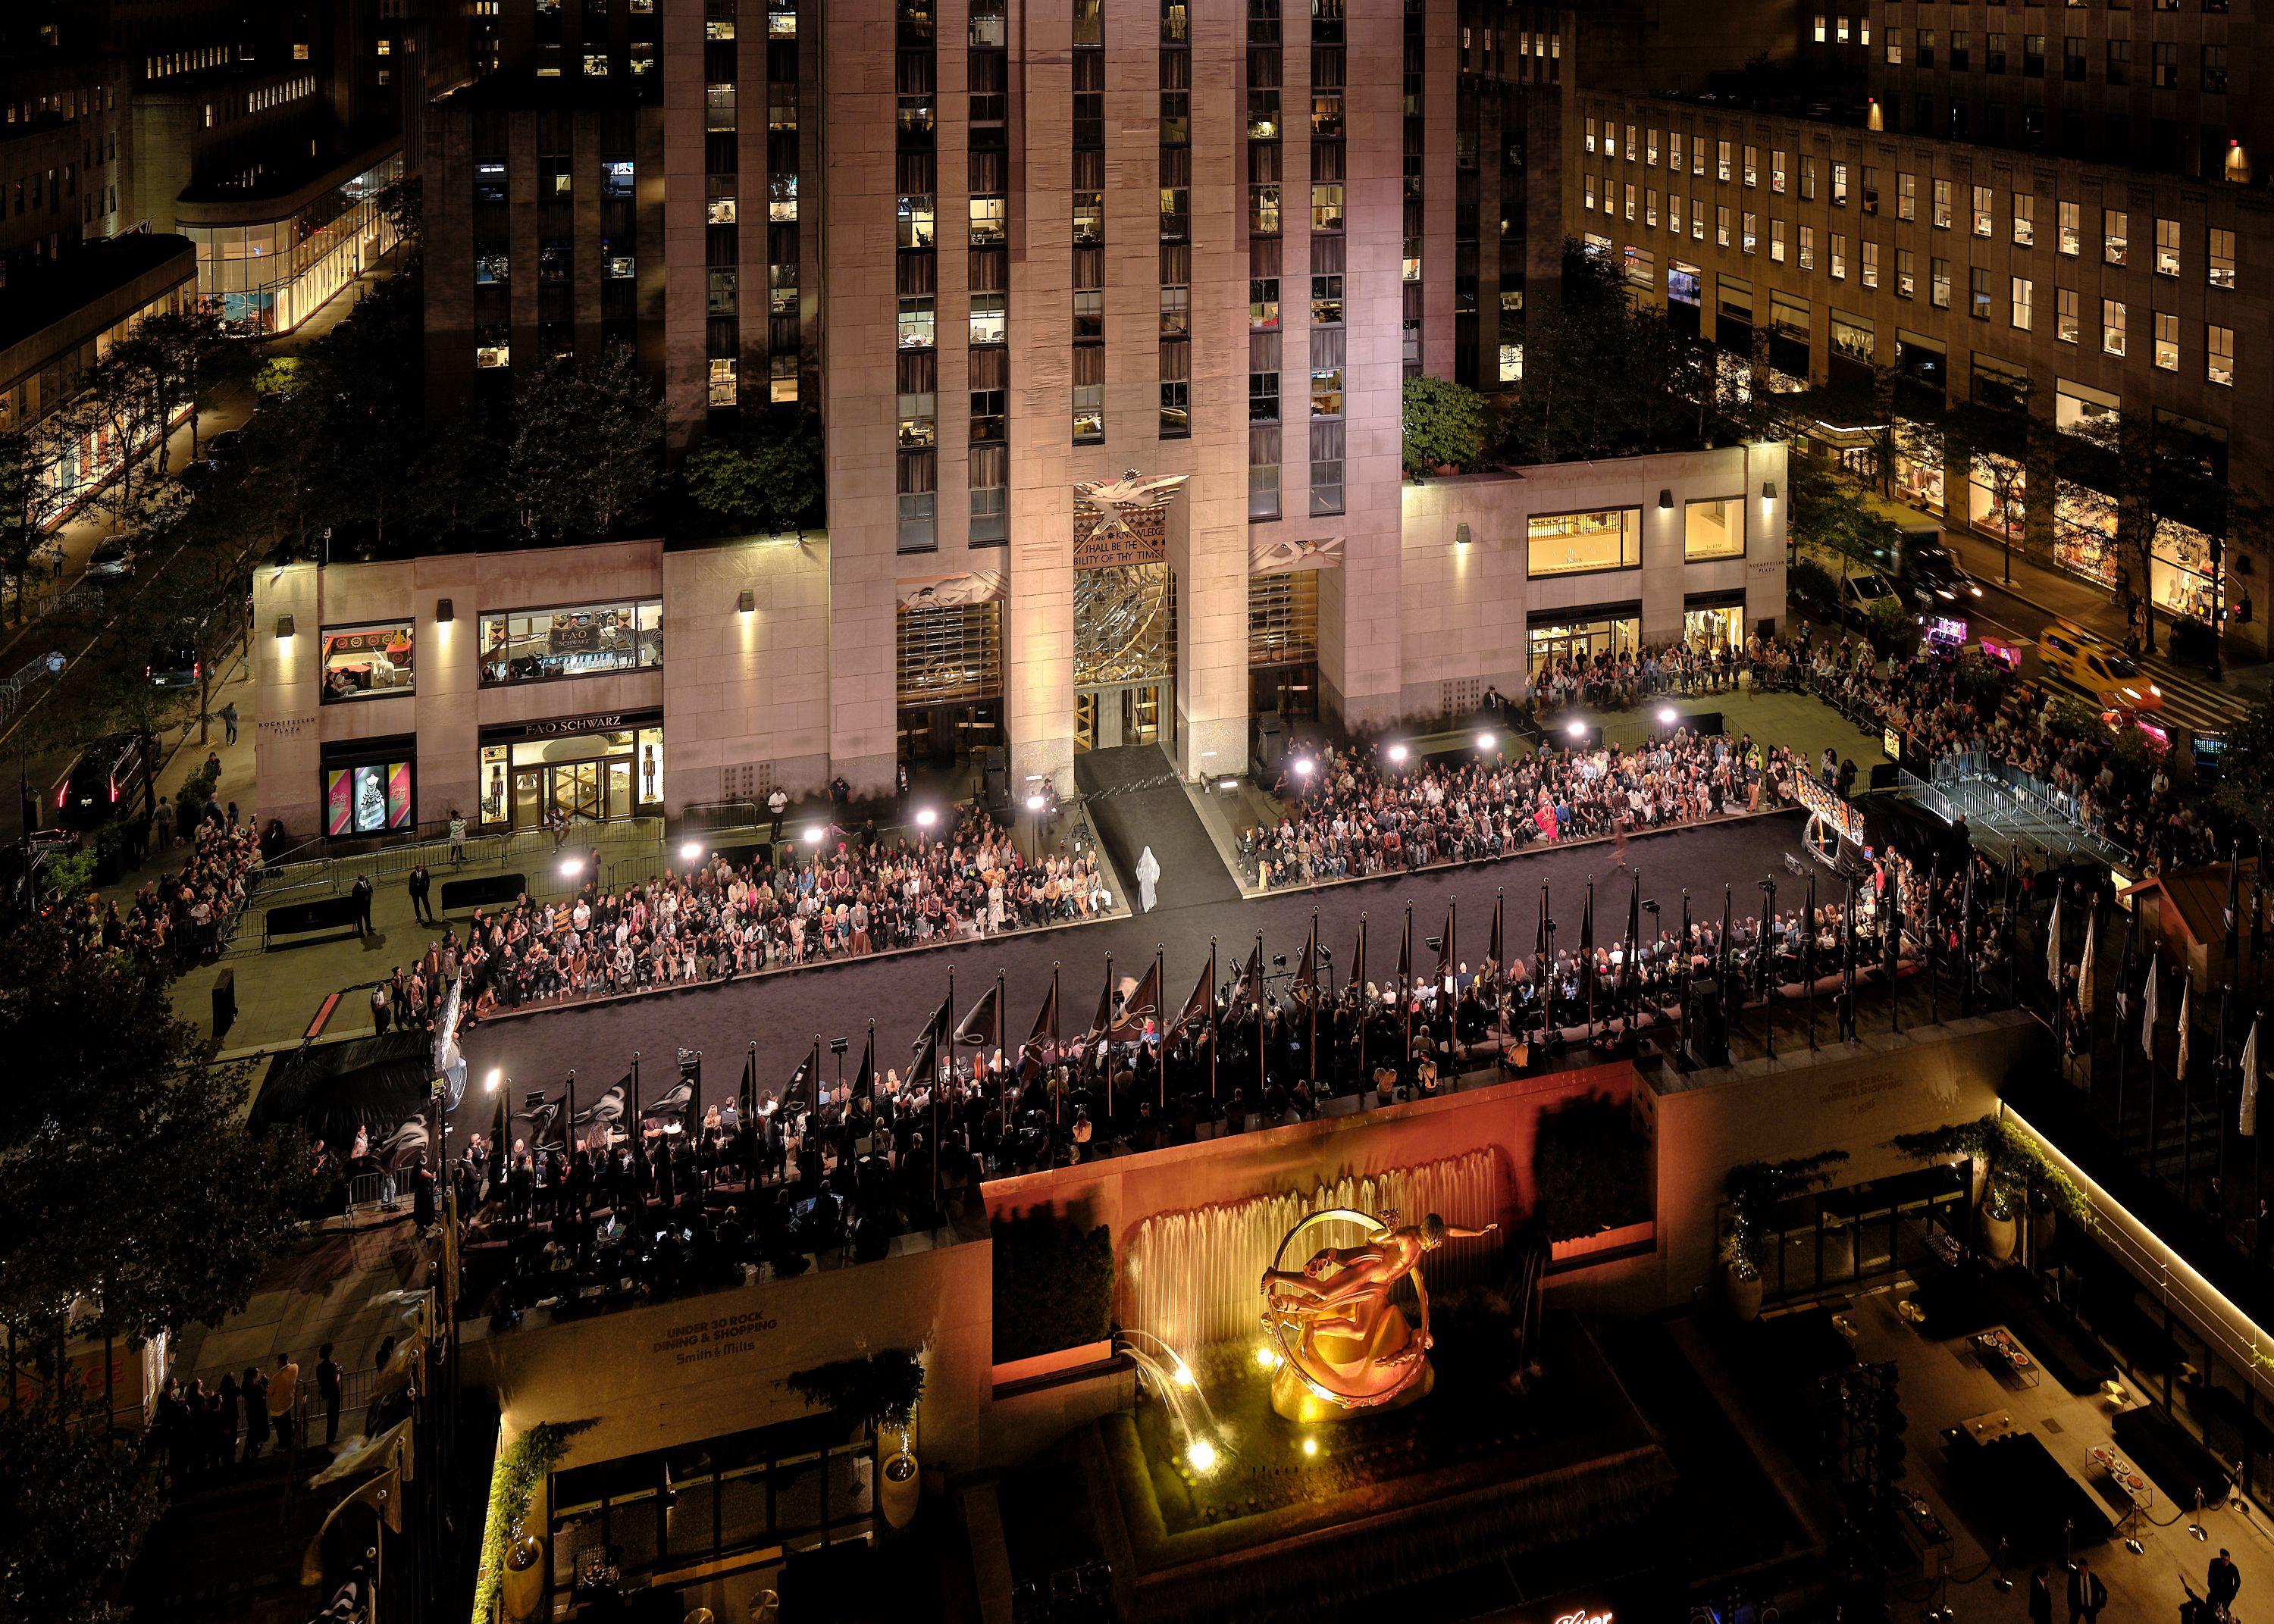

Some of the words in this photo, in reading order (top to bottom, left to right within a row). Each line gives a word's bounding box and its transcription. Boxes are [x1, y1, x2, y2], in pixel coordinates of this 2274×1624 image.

[1116, 527, 1165, 540] KNWLEDGE
[1084, 543, 1110, 554] SHALL
[1111, 542, 1121, 551] BE
[1124, 540, 1137, 549] THE
[1101, 554, 1114, 563] OF
[1117, 552, 1134, 562] THY
[558, 638, 590, 647] SCHWARZ
[258, 717, 315, 728] ROCKEFELLER
[559, 715, 621, 732] SCHWARZ
[1819, 1090, 1850, 1104] DINING
[1859, 1079, 1903, 1095] SHOPPING
[1828, 1079, 1856, 1093] UNDER
[667, 1322, 708, 1338] UNDER
[711, 1318, 727, 1330] 30
[729, 1310, 763, 1325] ROCK
[653, 1335, 699, 1353] DINING
[701, 1333, 710, 1343] &
[713, 1319, 778, 1341] SHOPPING
[676, 1349, 712, 1366] Smith
[714, 1346, 722, 1357] &
[723, 1341, 755, 1356] Mills
